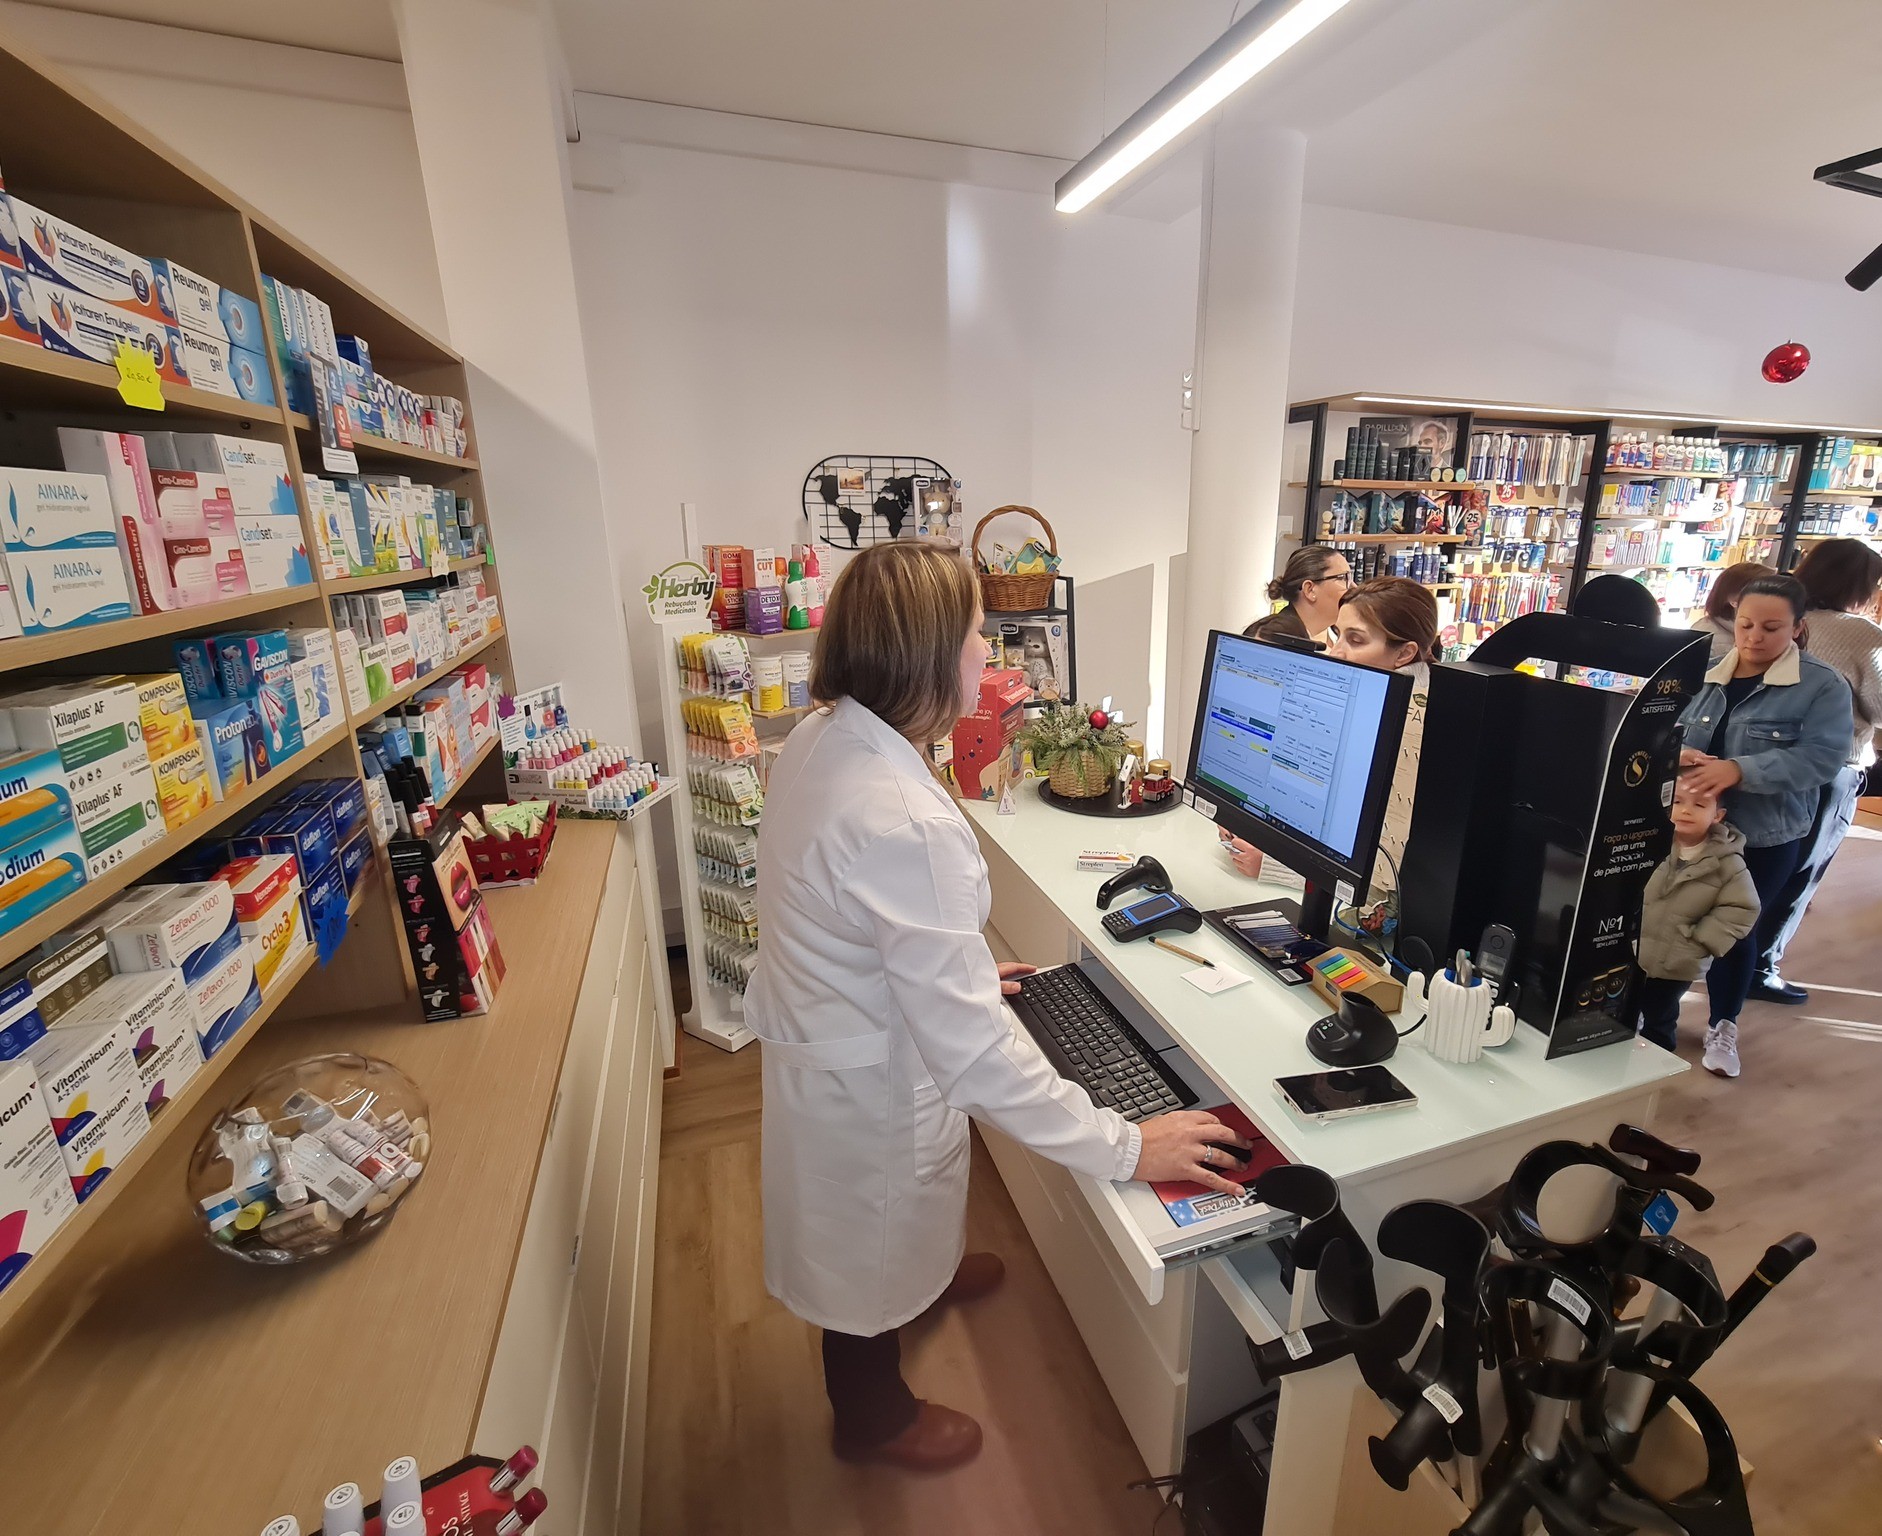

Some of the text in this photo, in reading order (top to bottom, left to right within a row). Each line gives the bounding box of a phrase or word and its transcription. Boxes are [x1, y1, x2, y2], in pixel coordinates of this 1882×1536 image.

[53, 226, 89, 253] Voltaren
[172, 267, 210, 297] Reumon
[68, 300, 105, 323] Voltaren
[199, 298, 213, 312] gel
[183, 332, 220, 358] Reumon
[210, 359, 223, 373] gel
[223, 445, 257, 464] Candiset
[38, 483, 79, 500] AINARA
[240, 522, 273, 541] Candiset
[53, 562, 94, 579] AINARA
[132, 529, 150, 609] Gino-Canesten
[757, 562, 773, 571] CUT
[659, 577, 714, 600] Herby
[760, 596, 780, 604] DETOX
[664, 600, 697, 608] Rebuçados
[664, 606, 697, 615] Medicinais
[254, 649, 288, 671] GAVISCON
[138, 679, 181, 704] KOMPENSAN
[1656, 679, 1682, 694] 98%
[54, 700, 106, 728] Xilaplus AF
[1641, 704, 1676, 715] SATISFEITAS
[214, 718, 247, 743] Proton
[158, 747, 200, 776] KOMPENSAN
[75, 783, 124, 816] Xilaplus AF
[335, 798, 354, 819] daflon
[302, 828, 322, 851] daflon
[1603, 835, 1621, 844] Faça
[1628, 827, 1659, 840] upgrade
[345, 848, 362, 869] daflon
[1611, 841, 1646, 855] para uma
[1593, 859, 1655, 878] de pele com pele
[310, 882, 330, 906] daflon
[169, 894, 220, 938] Zeflavon 1000
[261, 910, 292, 950] Cyclo 3
[146, 933, 162, 968] Zeflavon
[197, 958, 243, 1005] Zeflavon 1000
[125, 982, 175, 1027] Vitaminicum
[52, 1039, 115, 1095] Vitaminicum
[138, 1034, 185, 1081] Vitaminicum
[71, 1072, 91, 1090] TOTAL
[71, 1095, 130, 1154] Vitaminicum
[88, 1130, 108, 1148] TOTAL
